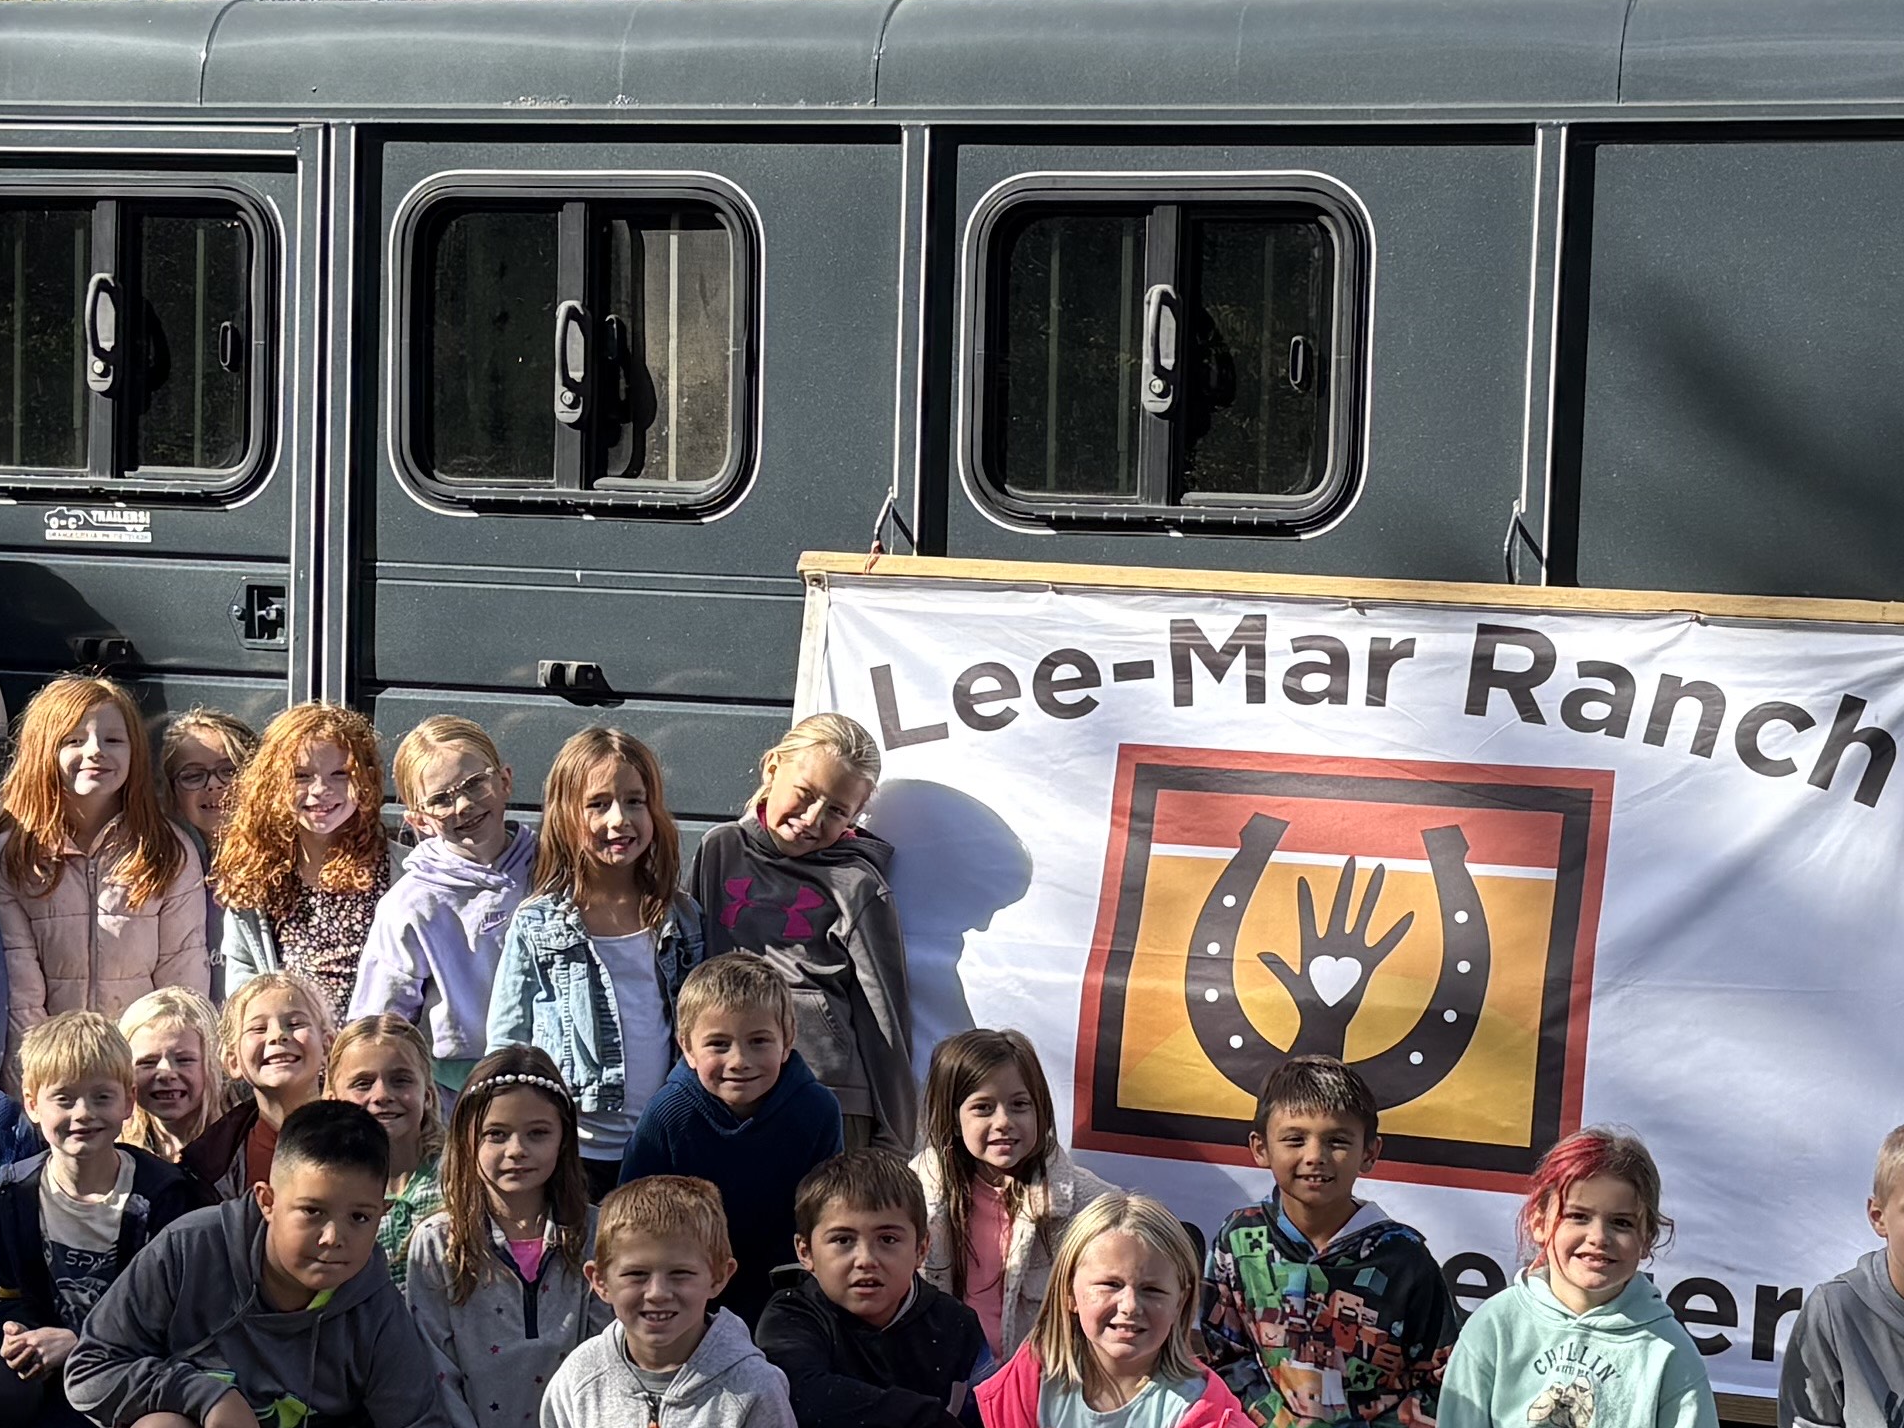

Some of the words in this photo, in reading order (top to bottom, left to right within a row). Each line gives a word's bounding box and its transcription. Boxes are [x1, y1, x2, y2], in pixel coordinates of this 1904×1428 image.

[869, 613, 1416, 753] Lee-Mar
[1463, 622, 1899, 809] Ranch
[1533, 1342, 1622, 1384] CHILLIN'
